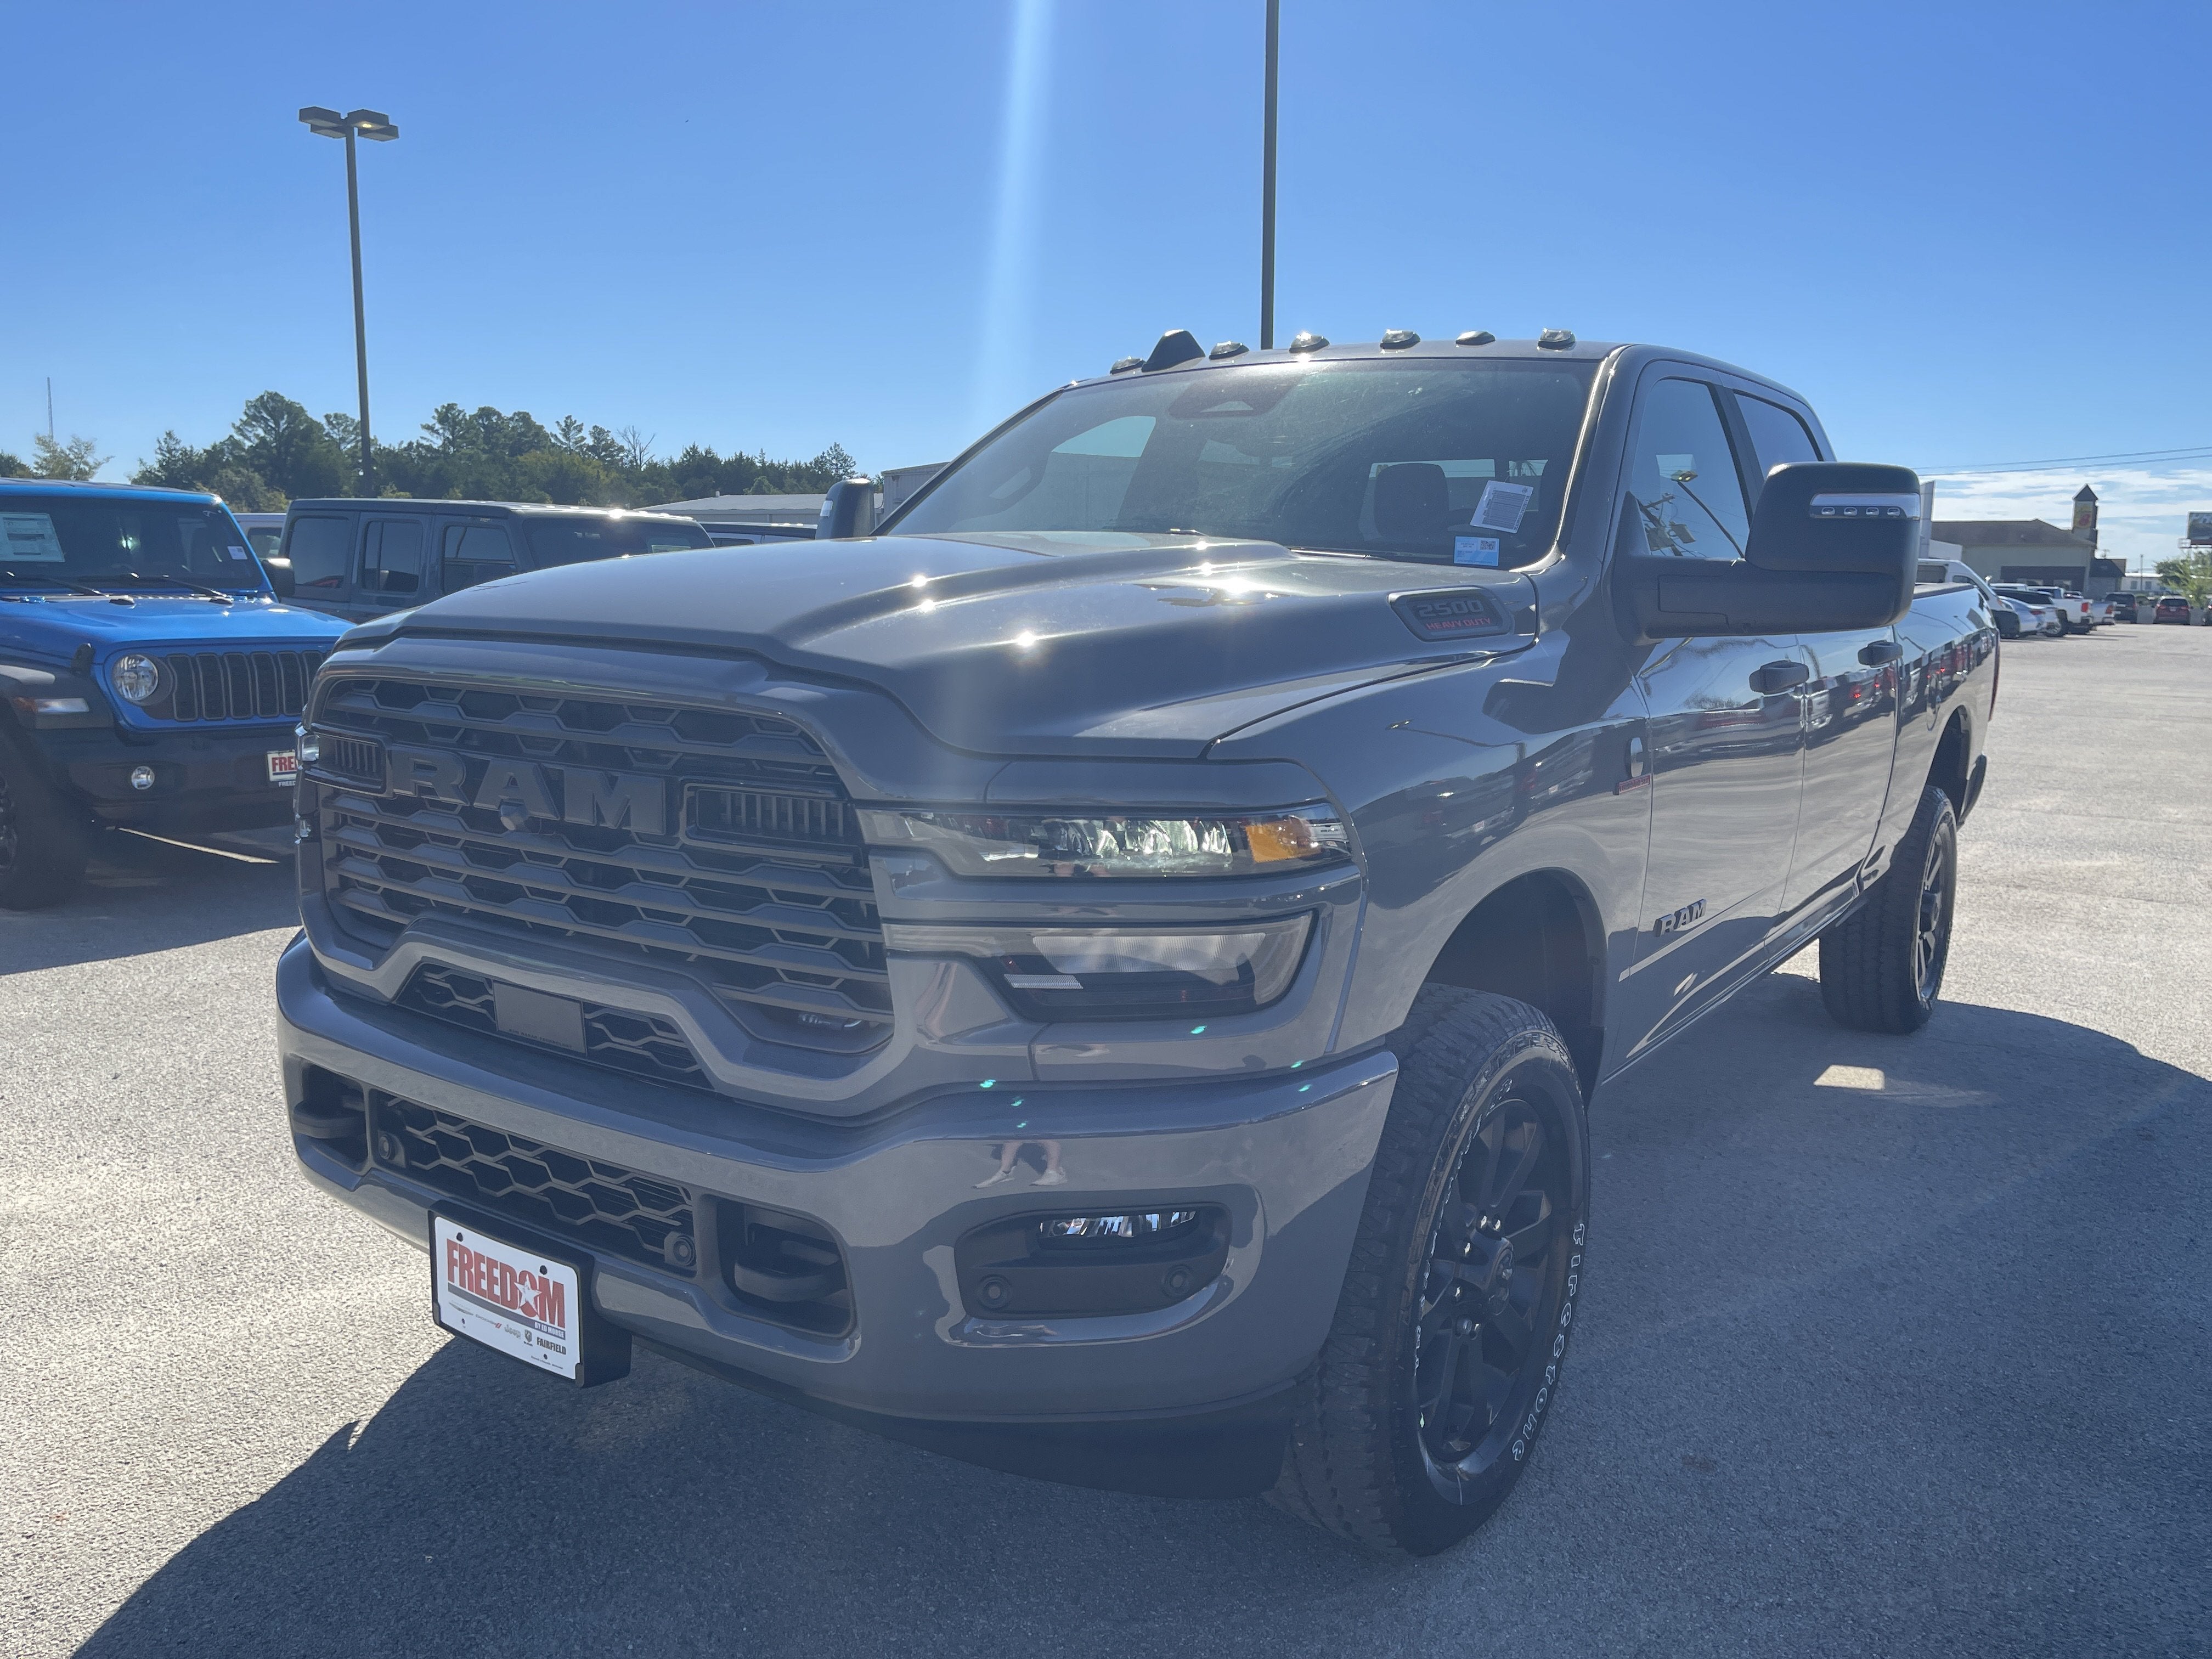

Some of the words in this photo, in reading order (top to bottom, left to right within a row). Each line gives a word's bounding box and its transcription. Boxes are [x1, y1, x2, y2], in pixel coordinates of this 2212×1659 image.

[1417, 600, 1484, 617] 2500
[1426, 620, 1462, 630] HEAVY
[1463, 618, 1491, 627] DUTY
[272, 756, 297, 772] FRE
[387, 744, 665, 835] RAM
[1655, 899, 1706, 936] RAM
[447, 1238, 566, 1329] FREEDOM
[537, 1336, 566, 1355] FAIRFIELD
[1512, 1223, 1585, 1462] Firestone
